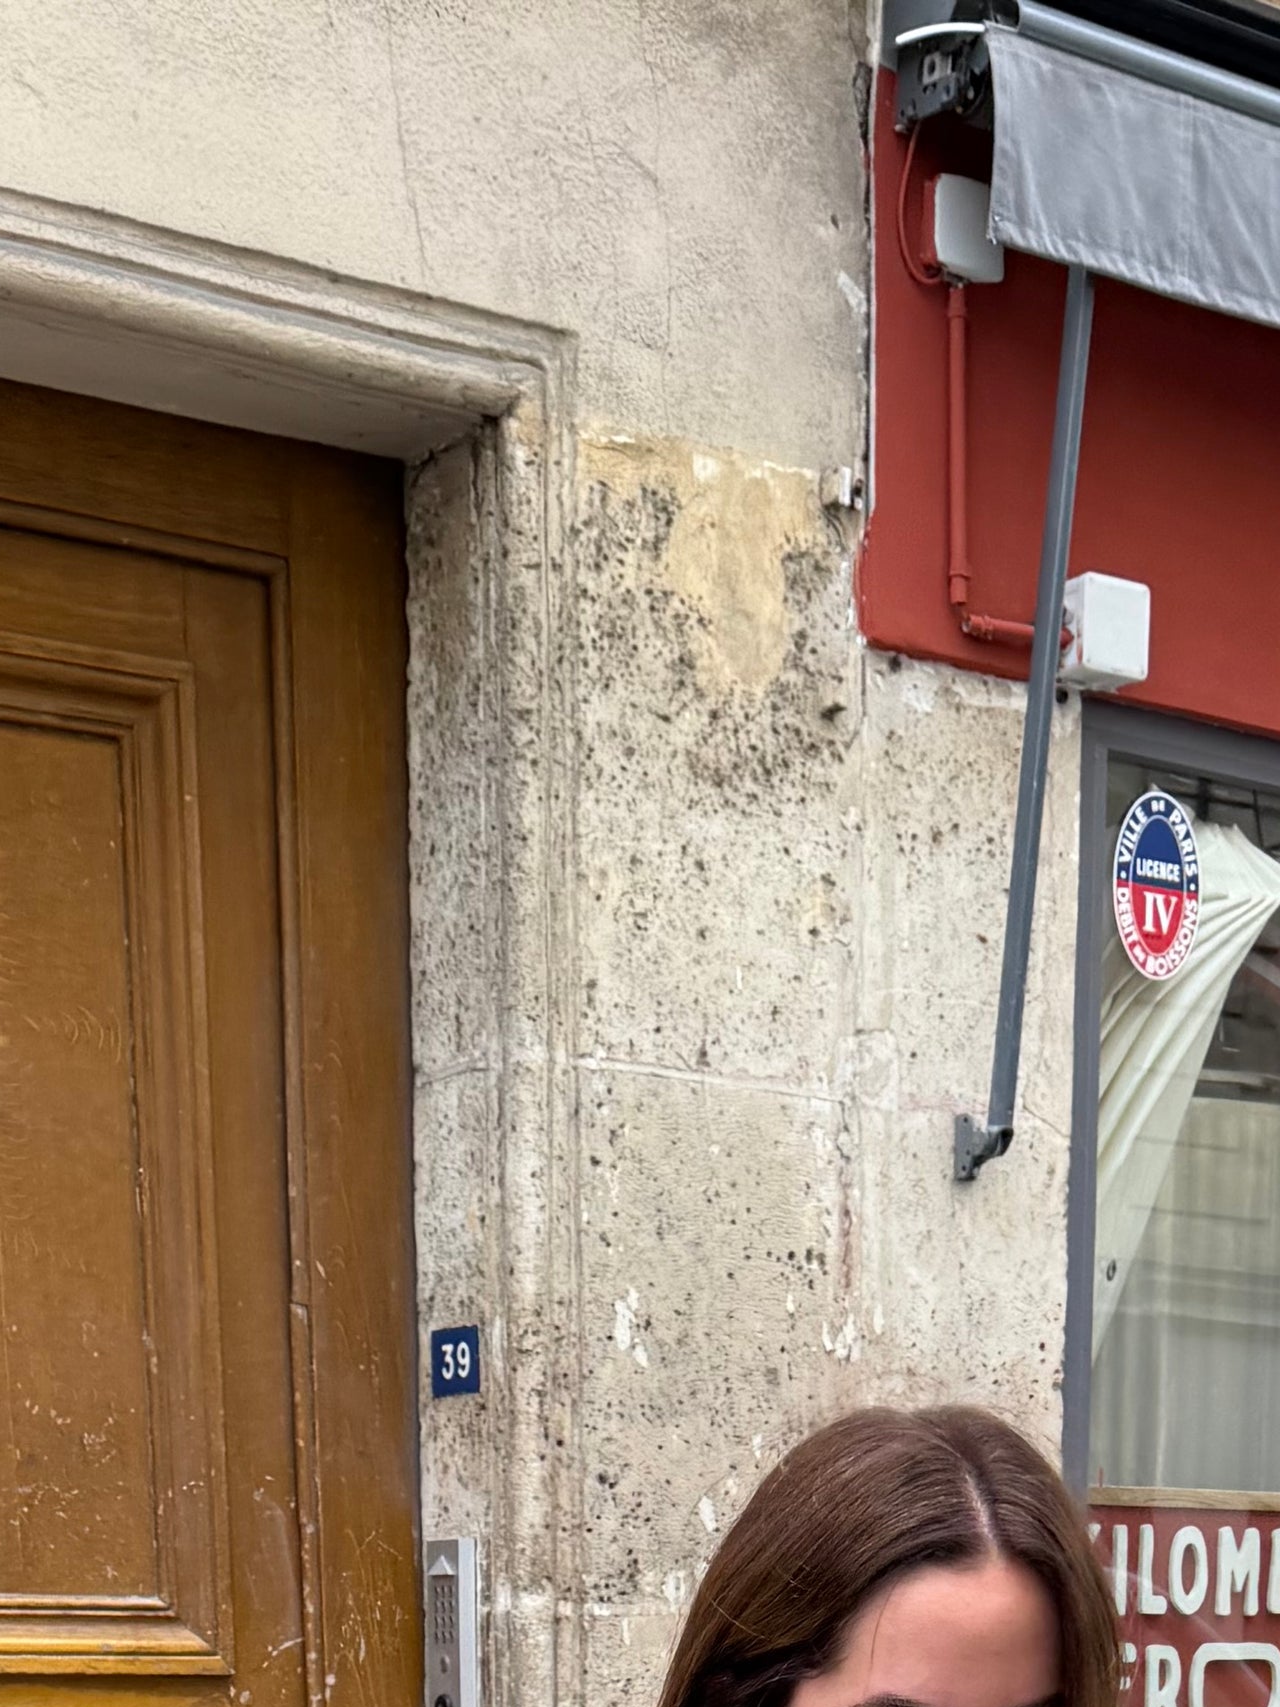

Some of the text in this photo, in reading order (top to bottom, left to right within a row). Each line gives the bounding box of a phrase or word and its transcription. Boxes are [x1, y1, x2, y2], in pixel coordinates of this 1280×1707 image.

[1118, 805, 1148, 863] VILLE
[1169, 808, 1198, 877] PARIS
[1136, 857, 1181, 882] LICENCE
[1117, 887, 1139, 942] DEBIT
[1145, 898, 1198, 975] BOISSONS
[1142, 890, 1178, 935] IV
[441, 1341, 471, 1381] 39
